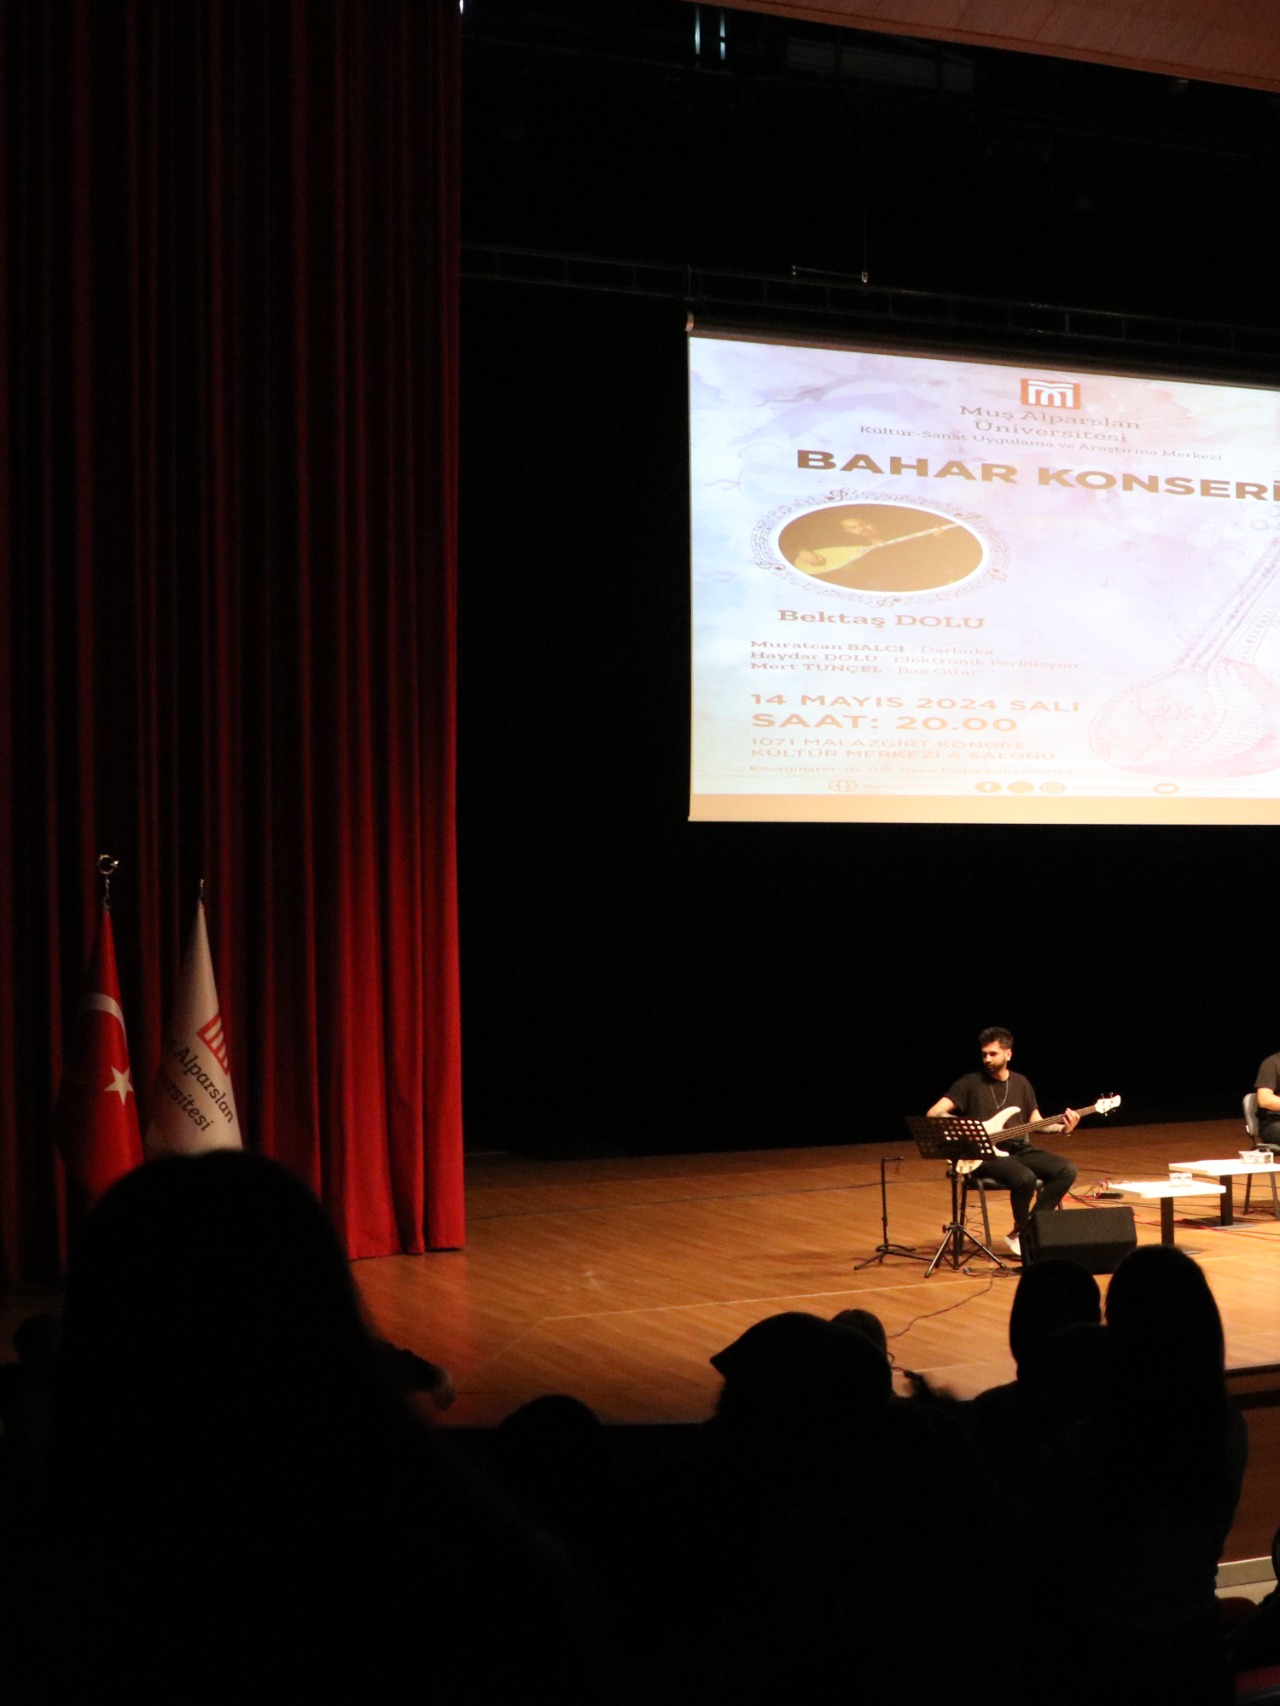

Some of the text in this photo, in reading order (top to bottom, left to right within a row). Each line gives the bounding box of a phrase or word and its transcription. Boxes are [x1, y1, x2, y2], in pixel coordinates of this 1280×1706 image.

[959, 405, 1141, 431] Muş Alparslan
[975, 419, 1127, 442] Üniversitesi
[973, 435, 1054, 448] Uygulama
[1162, 449, 1222, 461] Merkezi
[797, 449, 1018, 484] BAHAR
[778, 609, 985, 630] Bektaş DOLU
[750, 640, 842, 651] Muratcan
[750, 652, 820, 661] Haydar
[823, 653, 879, 662] DOLU
[750, 662, 798, 671] Mert
[751, 694, 1079, 712] 14 MAYIS 2024 SALI
[752, 713, 1018, 732] SAAT: 20.00
[752, 738, 795, 746] 1071
[938, 740, 1026, 749] KONGRE
[969, 751, 1055, 760] SALONU
[173, 1046, 234, 1123] Alparslan
[166, 1083, 215, 1131] rsitesi
